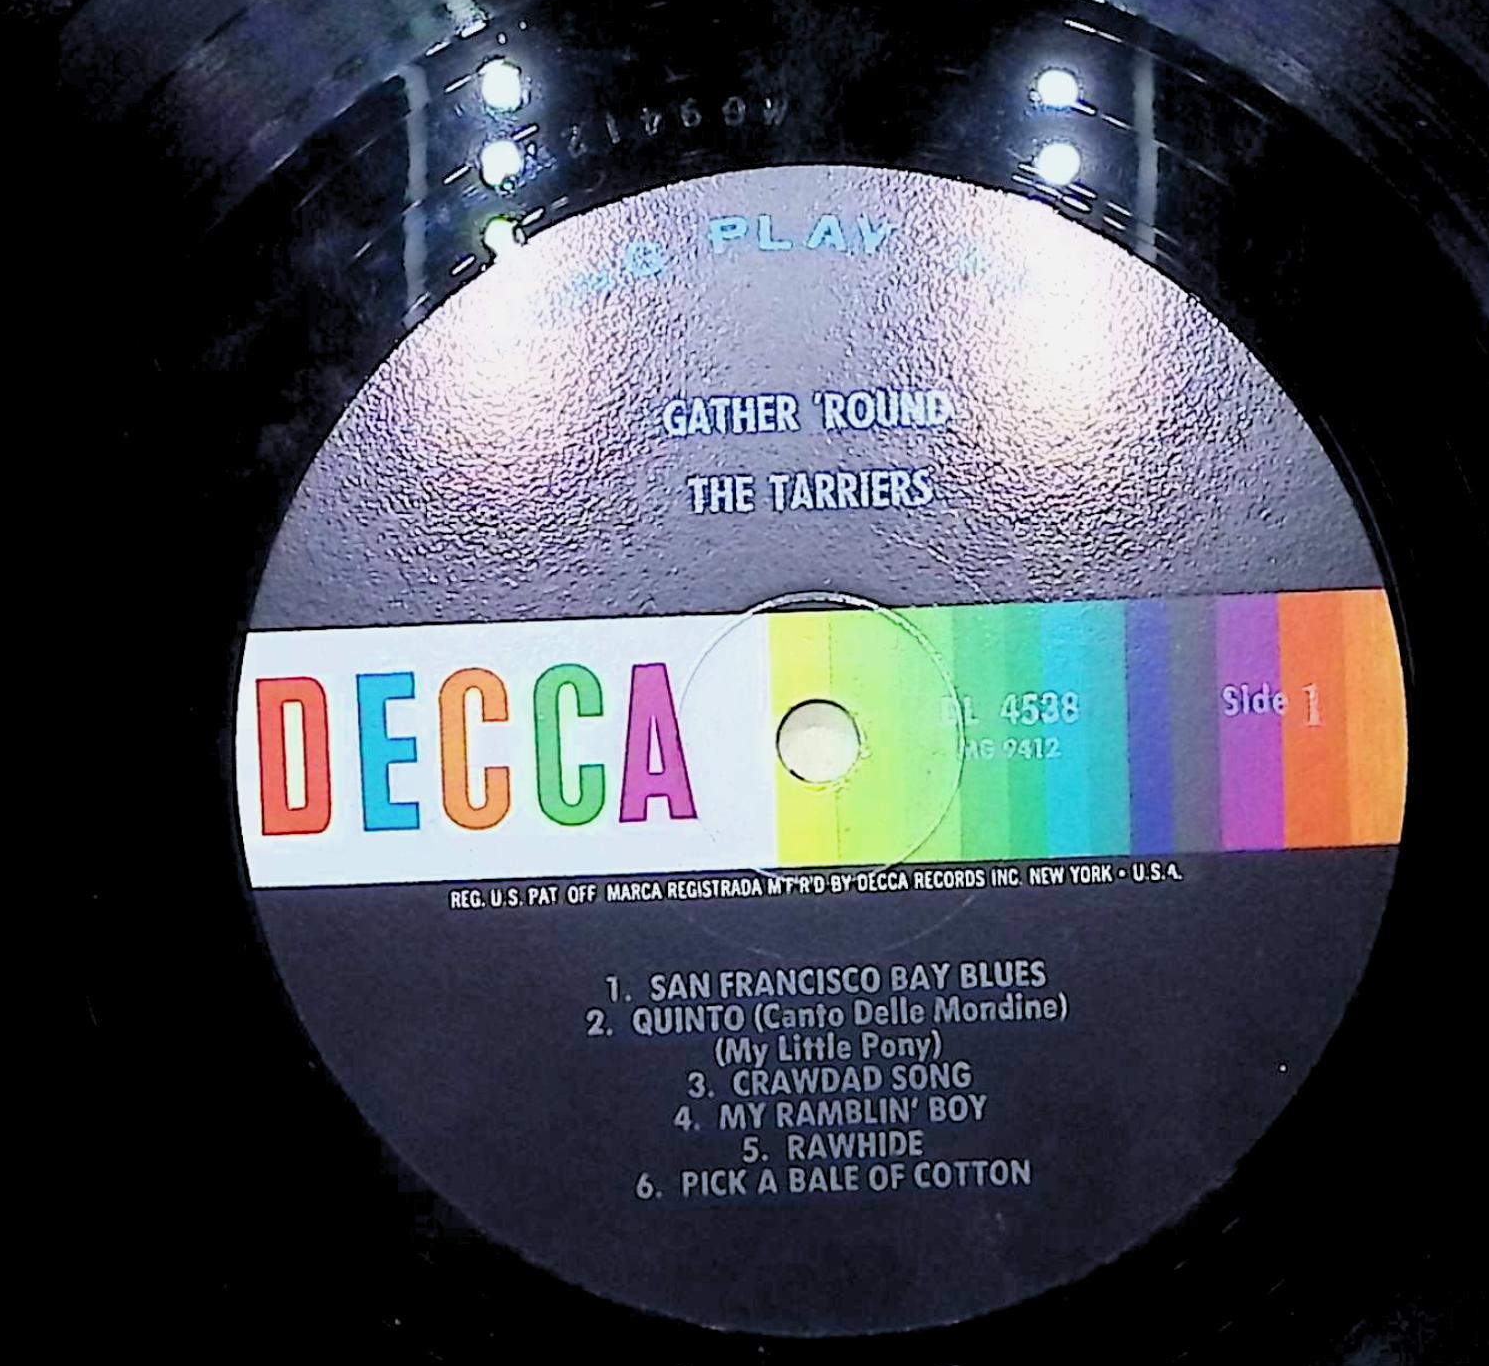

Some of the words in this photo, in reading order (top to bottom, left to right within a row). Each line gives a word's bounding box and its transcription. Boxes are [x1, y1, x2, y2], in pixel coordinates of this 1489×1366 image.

[708, 214, 894, 254] PLAY
[663, 394, 801, 436] GATHER
[687, 474, 755, 513] THE
[768, 469, 934, 511] TARRIERS
[1000, 691, 1079, 725] 4538
[1222, 682, 1288, 716] Side
[1302, 683, 1325, 727] 1
[256, 662, 698, 836] DECCA
[1003, 737, 1062, 759] 9412
[451, 889, 486, 909] REG.
[491, 888, 523, 908] U.S.
[607, 882, 662, 903] MARCA
[667, 878, 763, 901] REGISTRADA
[831, 874, 853, 893] BY
[855, 873, 908, 892] DECCA
[914, 870, 986, 890] RECORDS
[1029, 866, 1064, 886] NEW
[1069, 864, 1113, 884] YORK
[606, 975, 632, 1003] 1.
[650, 972, 711, 1002] SAN
[720, 967, 881, 999] FRANCISCO
[890, 963, 950, 991] BAY
[960, 960, 1047, 989] BLUES
[586, 1009, 613, 1036] 2.
[632, 1005, 745, 1036] QUINTO
[754, 1002, 845, 1032] (Canto
[854, 996, 925, 1026] Delle
[934, 992, 1067, 1023] Mondine)
[714, 1036, 768, 1067] (My
[778, 1031, 852, 1062] Little
[861, 1029, 942, 1062] Pony)
[687, 1072, 715, 1098] 3.
[733, 1066, 882, 1097] CRAWDAD
[892, 1060, 972, 1091] SONG
[673, 1105, 701, 1132] 4.
[718, 1102, 766, 1130] MY
[776, 1097, 918, 1128] RAMBLIN'
[929, 1094, 987, 1122] BOY
[742, 1136, 769, 1163] 5.
[787, 1130, 924, 1161] RAWHIDE
[635, 1172, 663, 1200] 6.
[682, 1169, 746, 1197] PICK
[758, 1168, 778, 1194] A
[788, 1165, 859, 1193] BALE
[868, 1164, 905, 1191] OF
[914, 1159, 1031, 1189] COTTON
